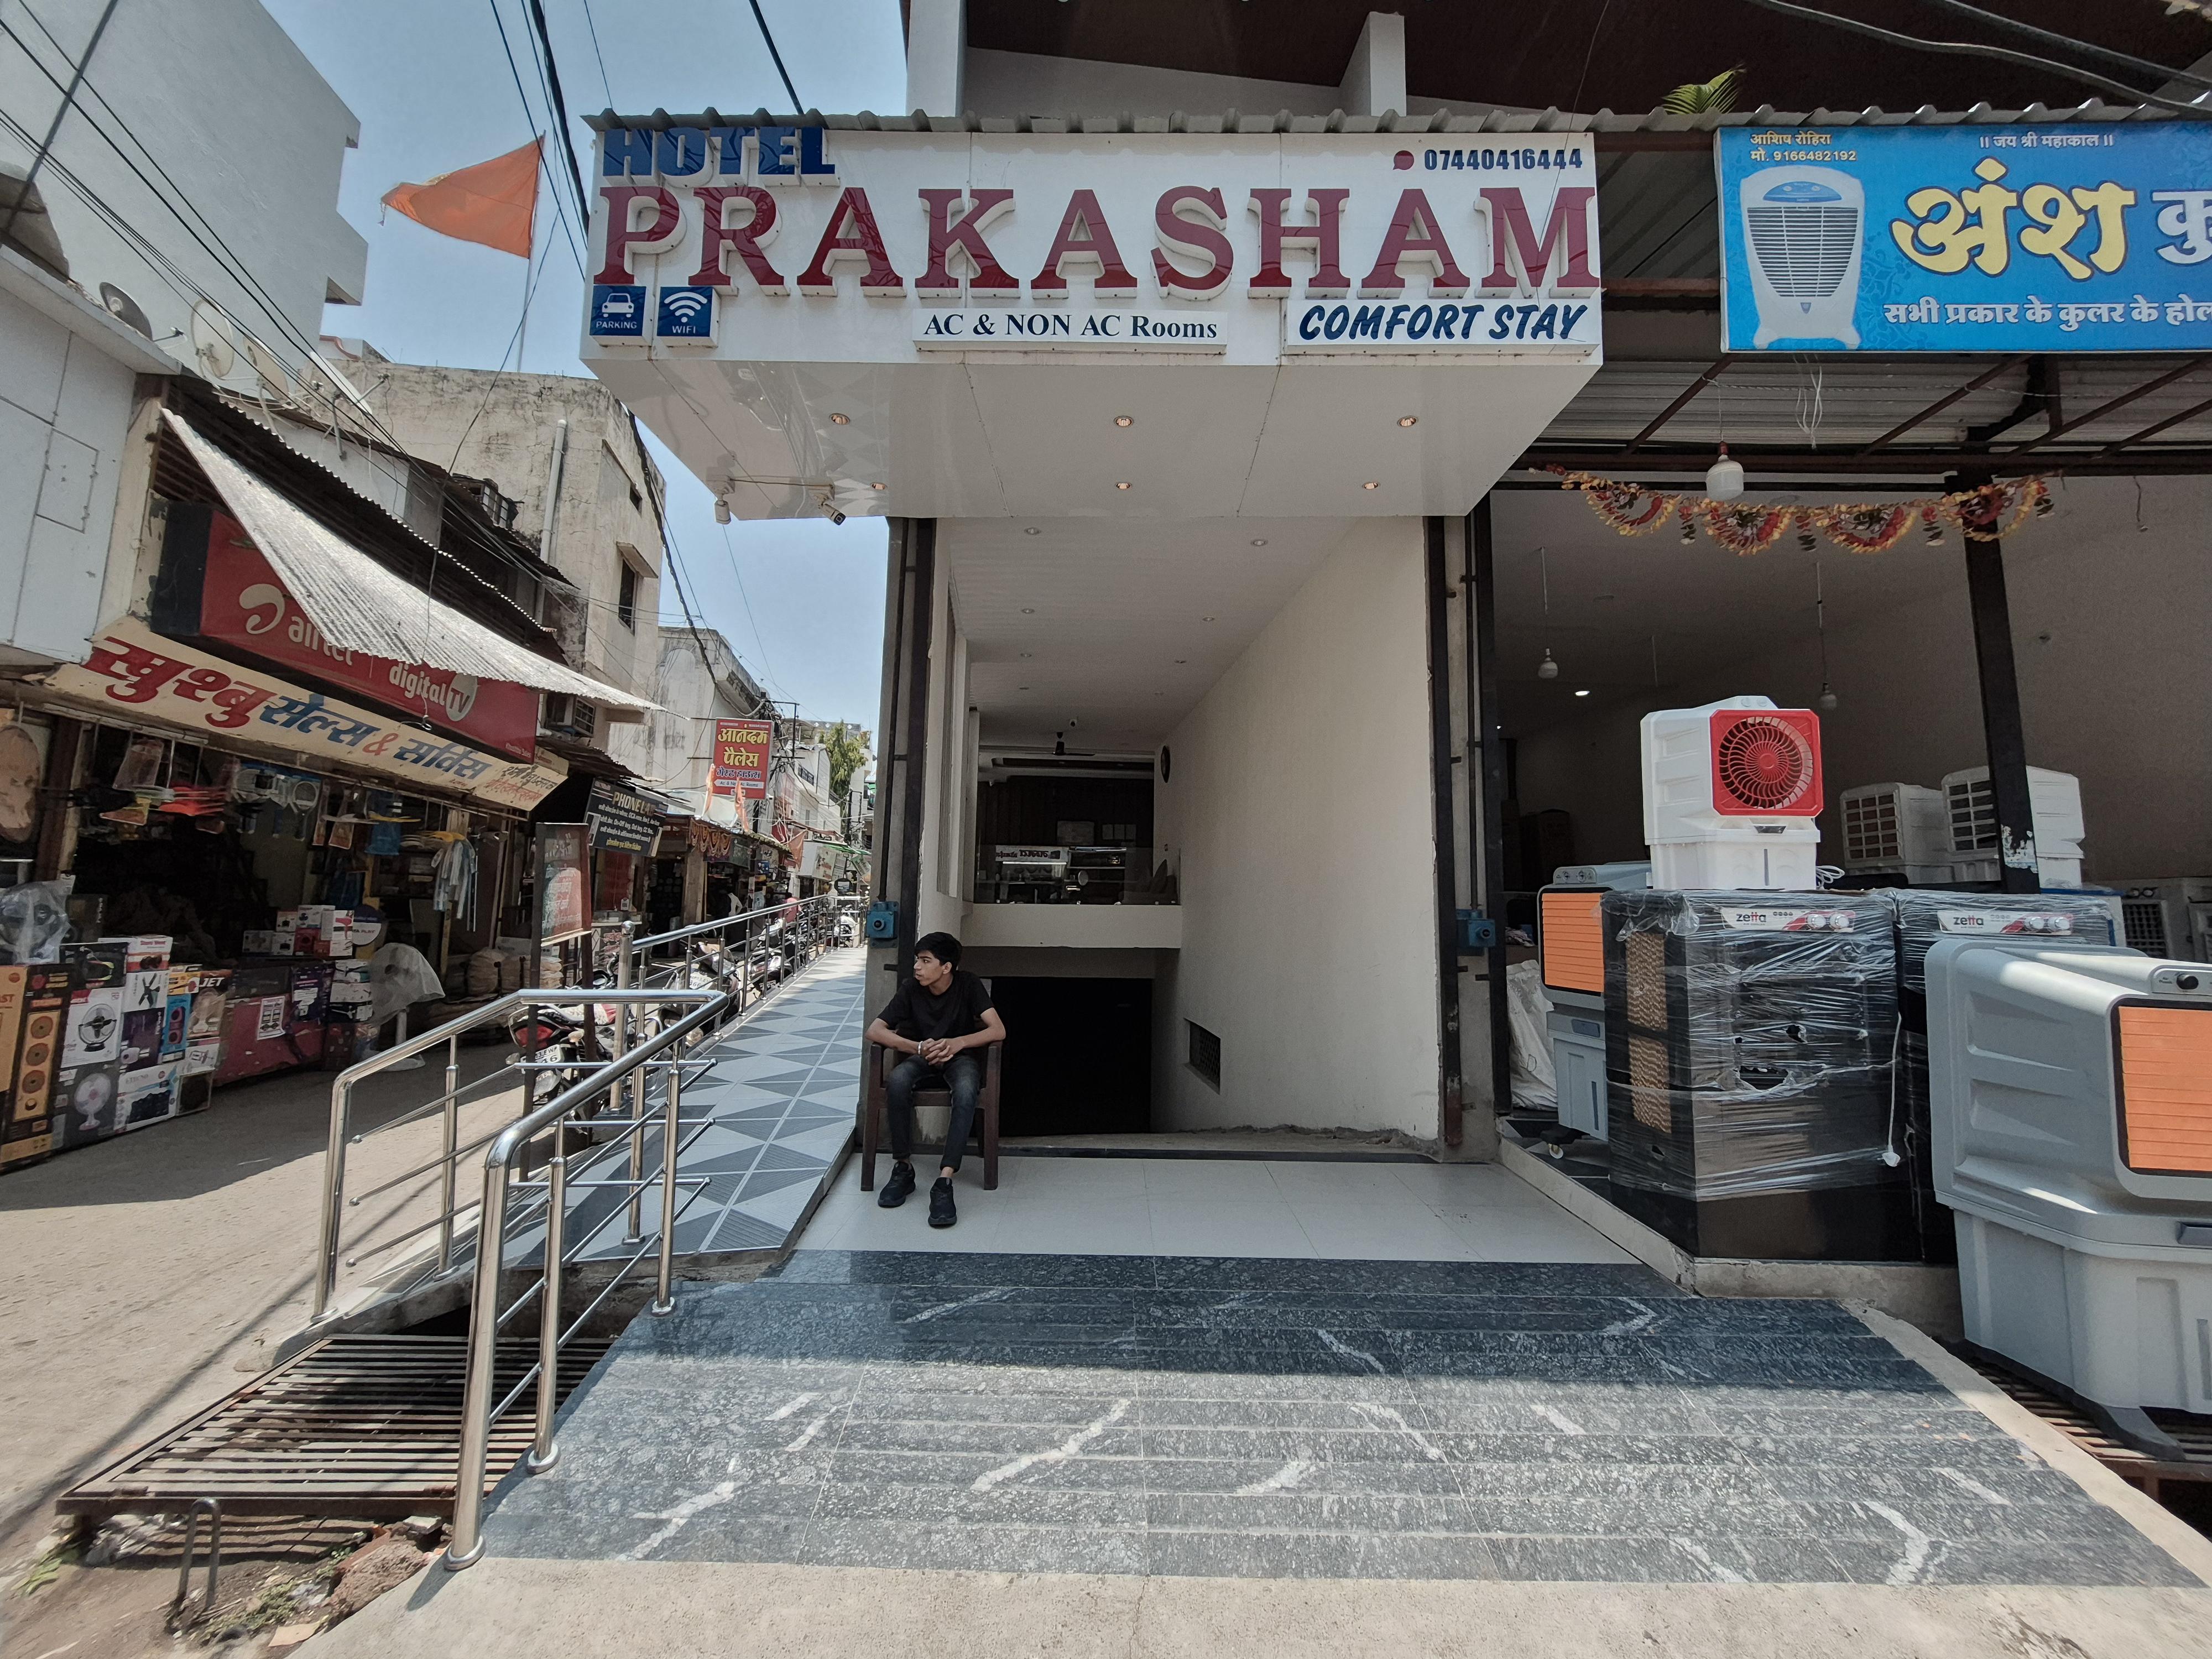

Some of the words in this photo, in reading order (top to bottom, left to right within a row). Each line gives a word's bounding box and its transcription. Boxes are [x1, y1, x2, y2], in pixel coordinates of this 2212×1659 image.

[1750, 131, 1792, 145] आशिष
[1795, 131, 1832, 145] रोहिरा
[1993, 135, 2017, 148] जय
[2021, 131, 2037, 148] श्री
[2040, 134, 2099, 149] महाकाल
[602, 126, 836, 176] HOTEL
[1423, 149, 1583, 170] 07440416444
[1773, 150, 1857, 161] 9166482192
[593, 185, 1601, 291] PRAKASHAM
[1298, 304, 1484, 341] COMFORT
[1488, 304, 1588, 341] STAY
[1883, 296, 1940, 324] सभी
[1944, 302, 2020, 324] प्रकार
[2023, 295, 2052, 324] के
[2057, 302, 2125, 331] कुलर
[2130, 294, 2158, 323] के
[595, 320, 638, 330] PARKING
[671, 324, 696, 335] WIFI
[924, 314, 964, 336] AC
[973, 313, 996, 336] &
[1004, 314, 1071, 336] NON
[1079, 314, 1121, 337] AC
[1130, 315, 1217, 339] Rooms
[388, 662, 447, 707] digital
[449, 687, 471, 713] TV
[362, 732, 399, 756] &
[612, 791, 642, 812] PHONE
[1736, 911, 1767, 922] zetta
[1953, 915, 1984, 926] zetta
[199, 977, 225, 987] JET
